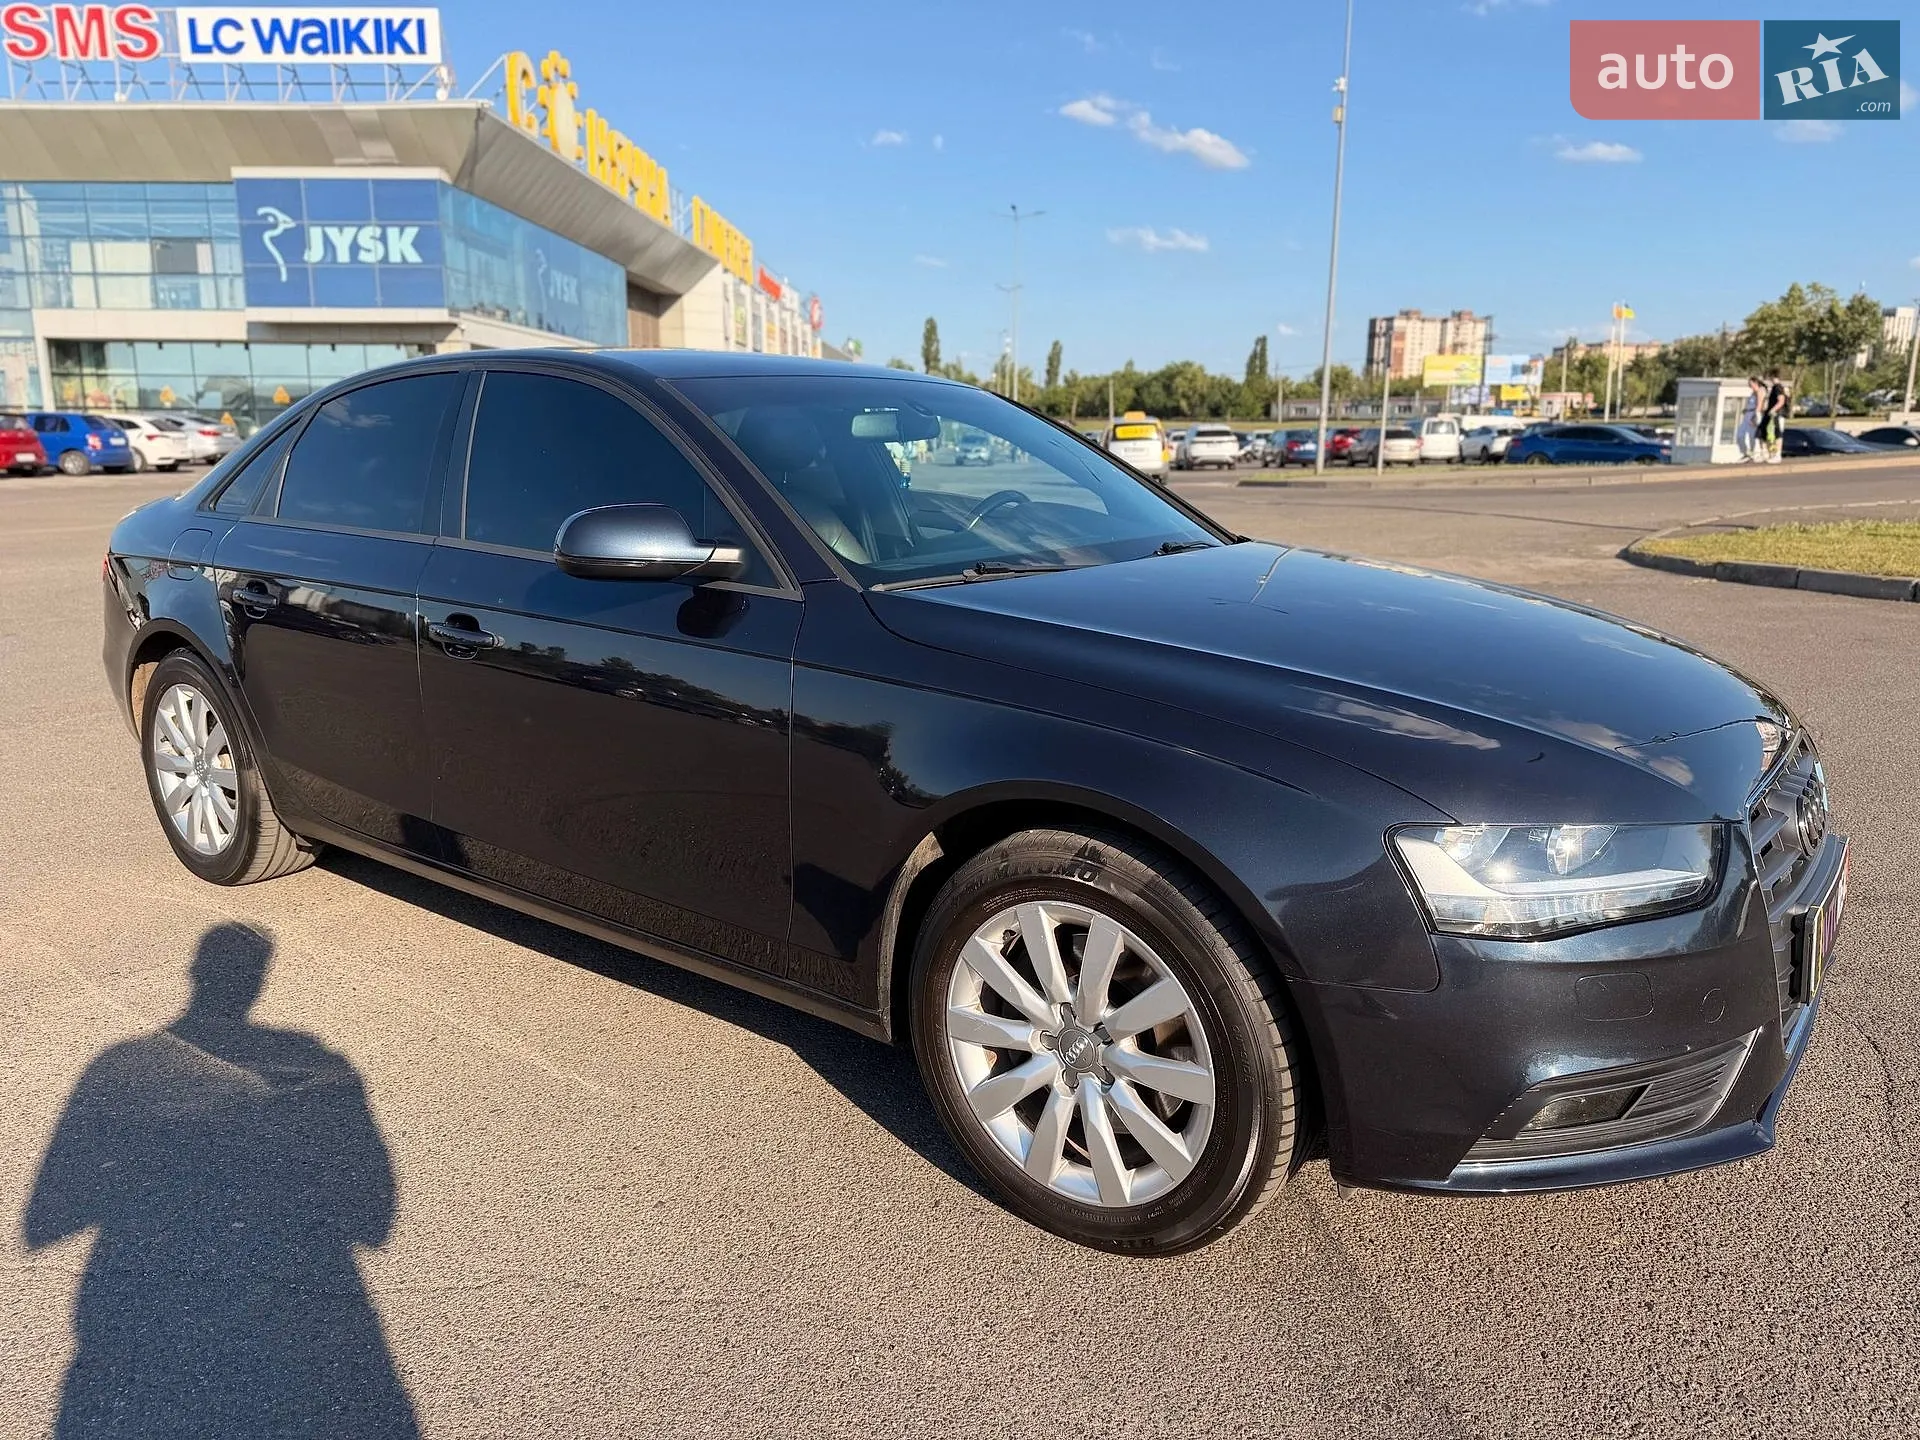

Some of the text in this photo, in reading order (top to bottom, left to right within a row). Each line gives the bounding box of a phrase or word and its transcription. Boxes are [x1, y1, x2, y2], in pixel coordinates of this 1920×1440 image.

[2, 4, 159, 59] SMS
[188, 18, 245, 55] LC
[303, 226, 423, 264] JYSK
